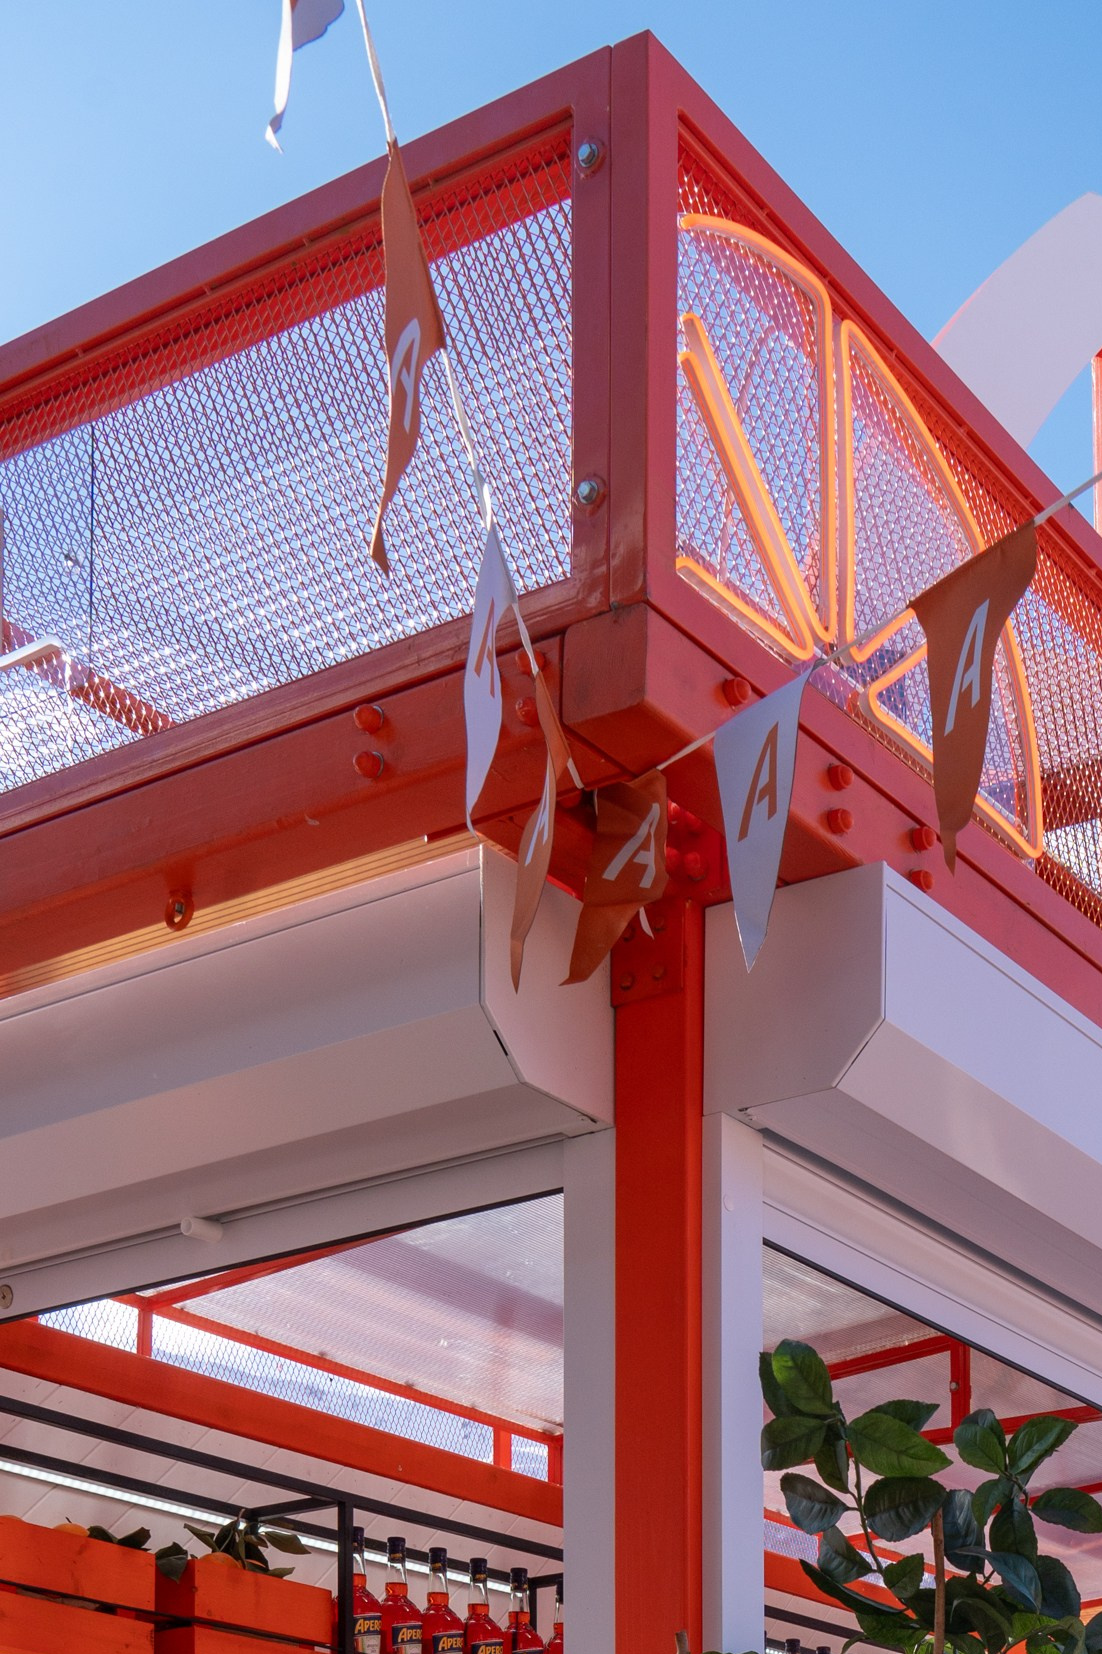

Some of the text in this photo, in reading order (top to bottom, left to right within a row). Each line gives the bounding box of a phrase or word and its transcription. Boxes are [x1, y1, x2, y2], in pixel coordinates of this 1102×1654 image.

[944, 598, 990, 736] A
[737, 720, 779, 842] A
[602, 802, 660, 889] A
